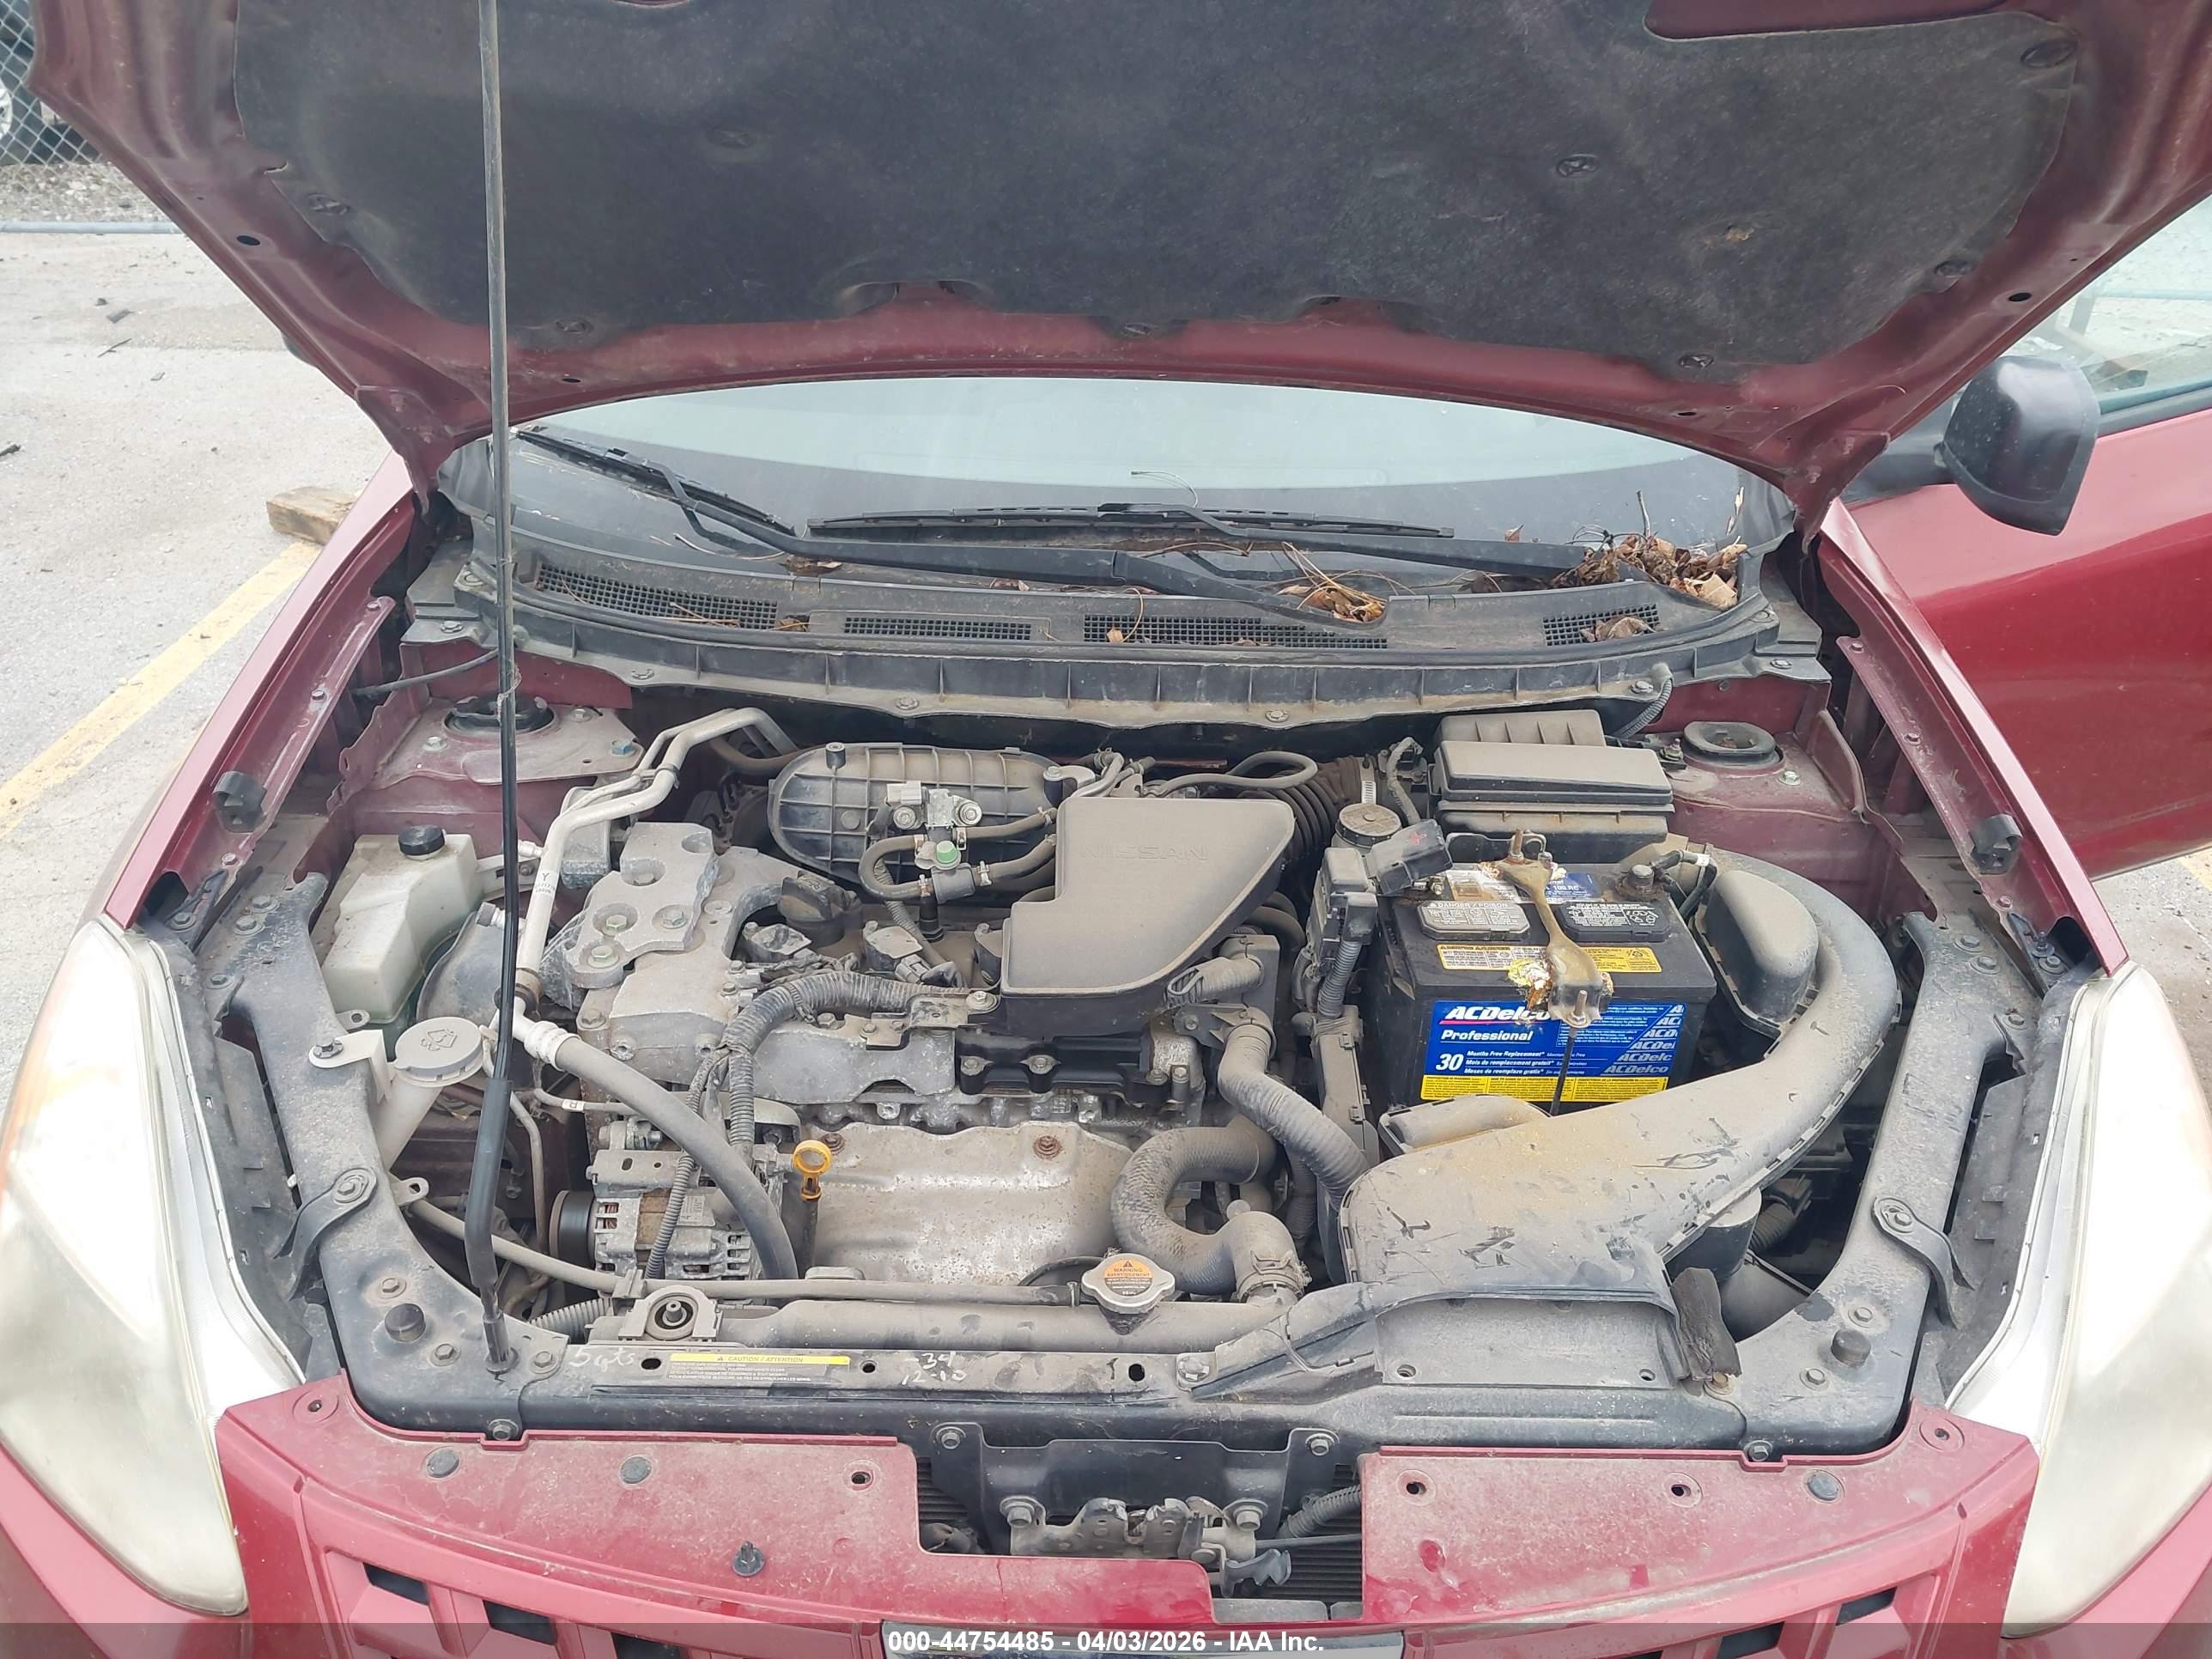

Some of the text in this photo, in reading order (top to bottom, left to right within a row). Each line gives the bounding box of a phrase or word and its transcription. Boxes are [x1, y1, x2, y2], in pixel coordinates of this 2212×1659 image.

[1079, 844, 1208, 860] NISSAN
[1444, 1006, 1550, 1020] ACDelco
[1441, 1029, 1534, 1041] Professional
[1435, 1054, 1464, 1071] 30
[1603, 1065, 1668, 1073] ACDelco
[568, 1346, 598, 1368] 5
